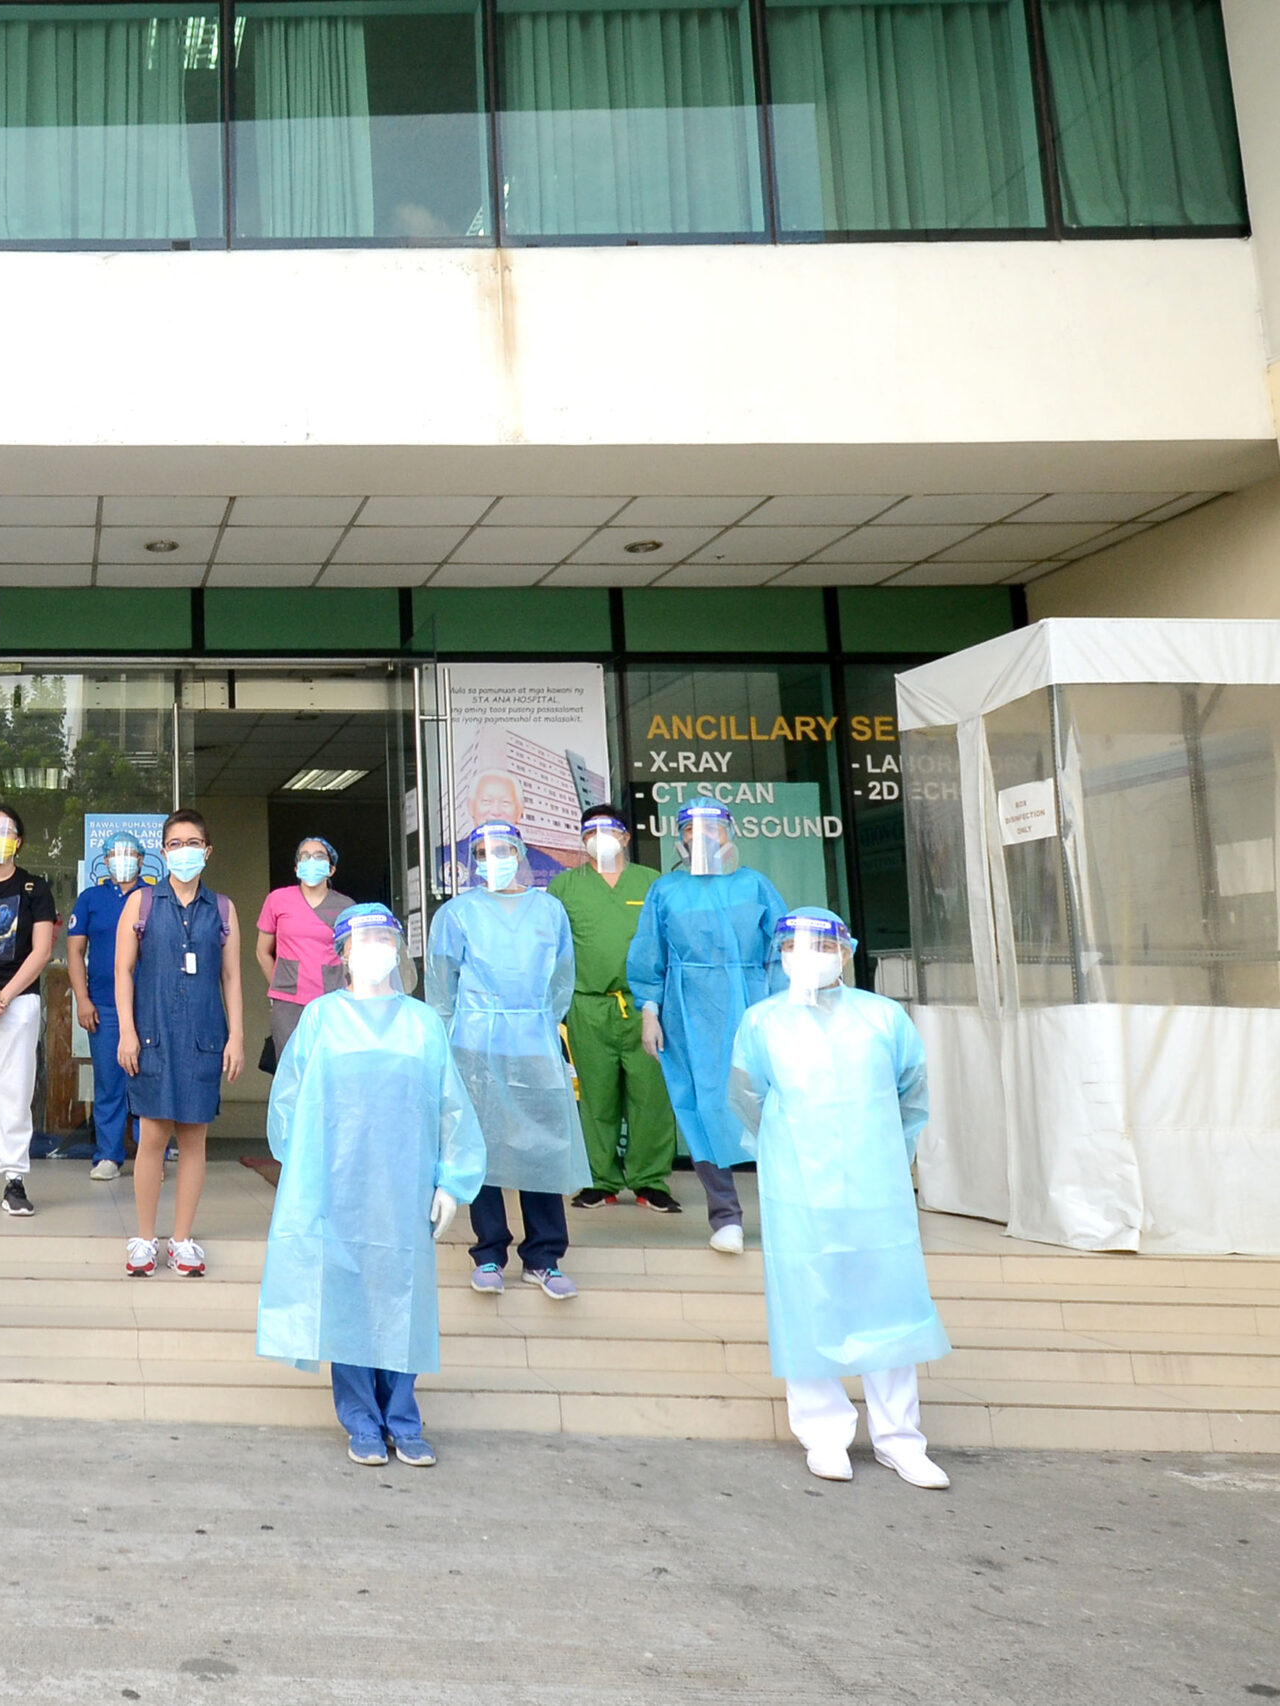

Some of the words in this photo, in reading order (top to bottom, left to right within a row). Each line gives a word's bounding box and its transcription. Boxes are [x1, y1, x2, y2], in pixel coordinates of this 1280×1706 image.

[472, 695, 489, 704] STA
[492, 695, 511, 704] ANA
[646, 714, 839, 741] ANCILLARY
[649, 751, 733, 773] X-RAY
[651, 782, 687, 804] CT
[697, 782, 774, 805] SCAN
[867, 781, 899, 800] 2D
[90, 829, 113, 838] ANG
[649, 814, 843, 839] ULASOUND
